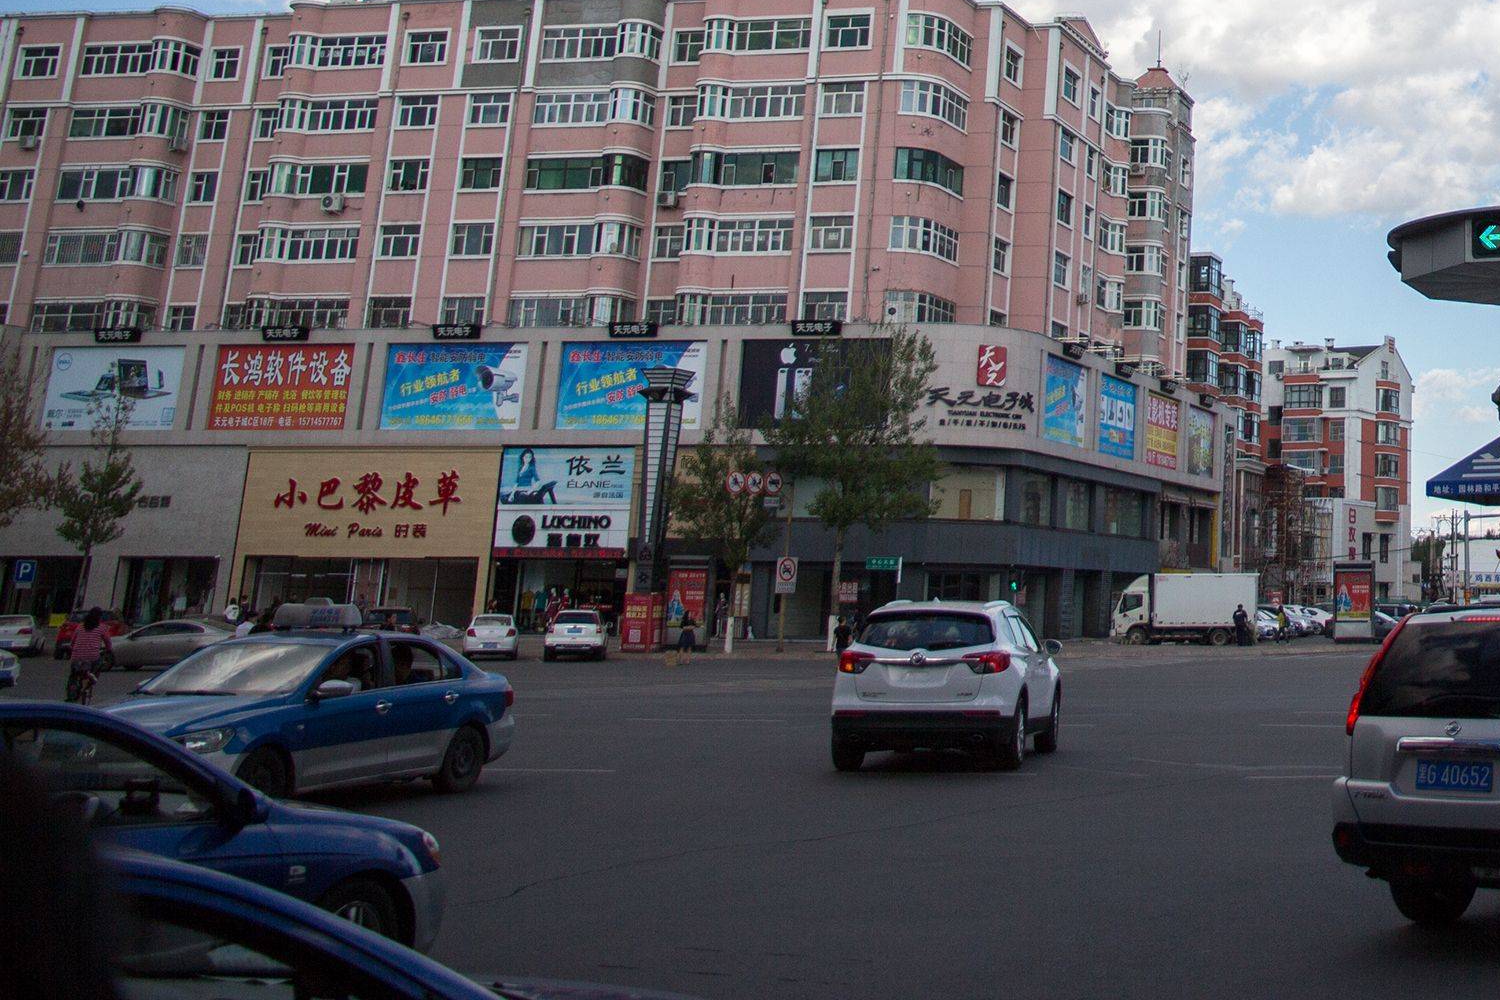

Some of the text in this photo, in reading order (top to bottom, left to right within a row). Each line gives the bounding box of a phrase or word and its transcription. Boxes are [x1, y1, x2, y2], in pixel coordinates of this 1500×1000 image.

[266, 328, 299, 338] 天元电子
[437, 326, 471, 336] 天元电子
[614, 324, 649, 334] 天元电子
[796, 322, 833, 332] 天元电子
[222, 349, 352, 386] 长鸿软件设备
[566, 454, 626, 476] 依兰
[274, 469, 462, 516] 小巴黎皮草
[541, 514, 612, 530] LUCHINO
[303, 522, 428, 539] Mini Paris 时装
[19, 563, 31, 577] P
